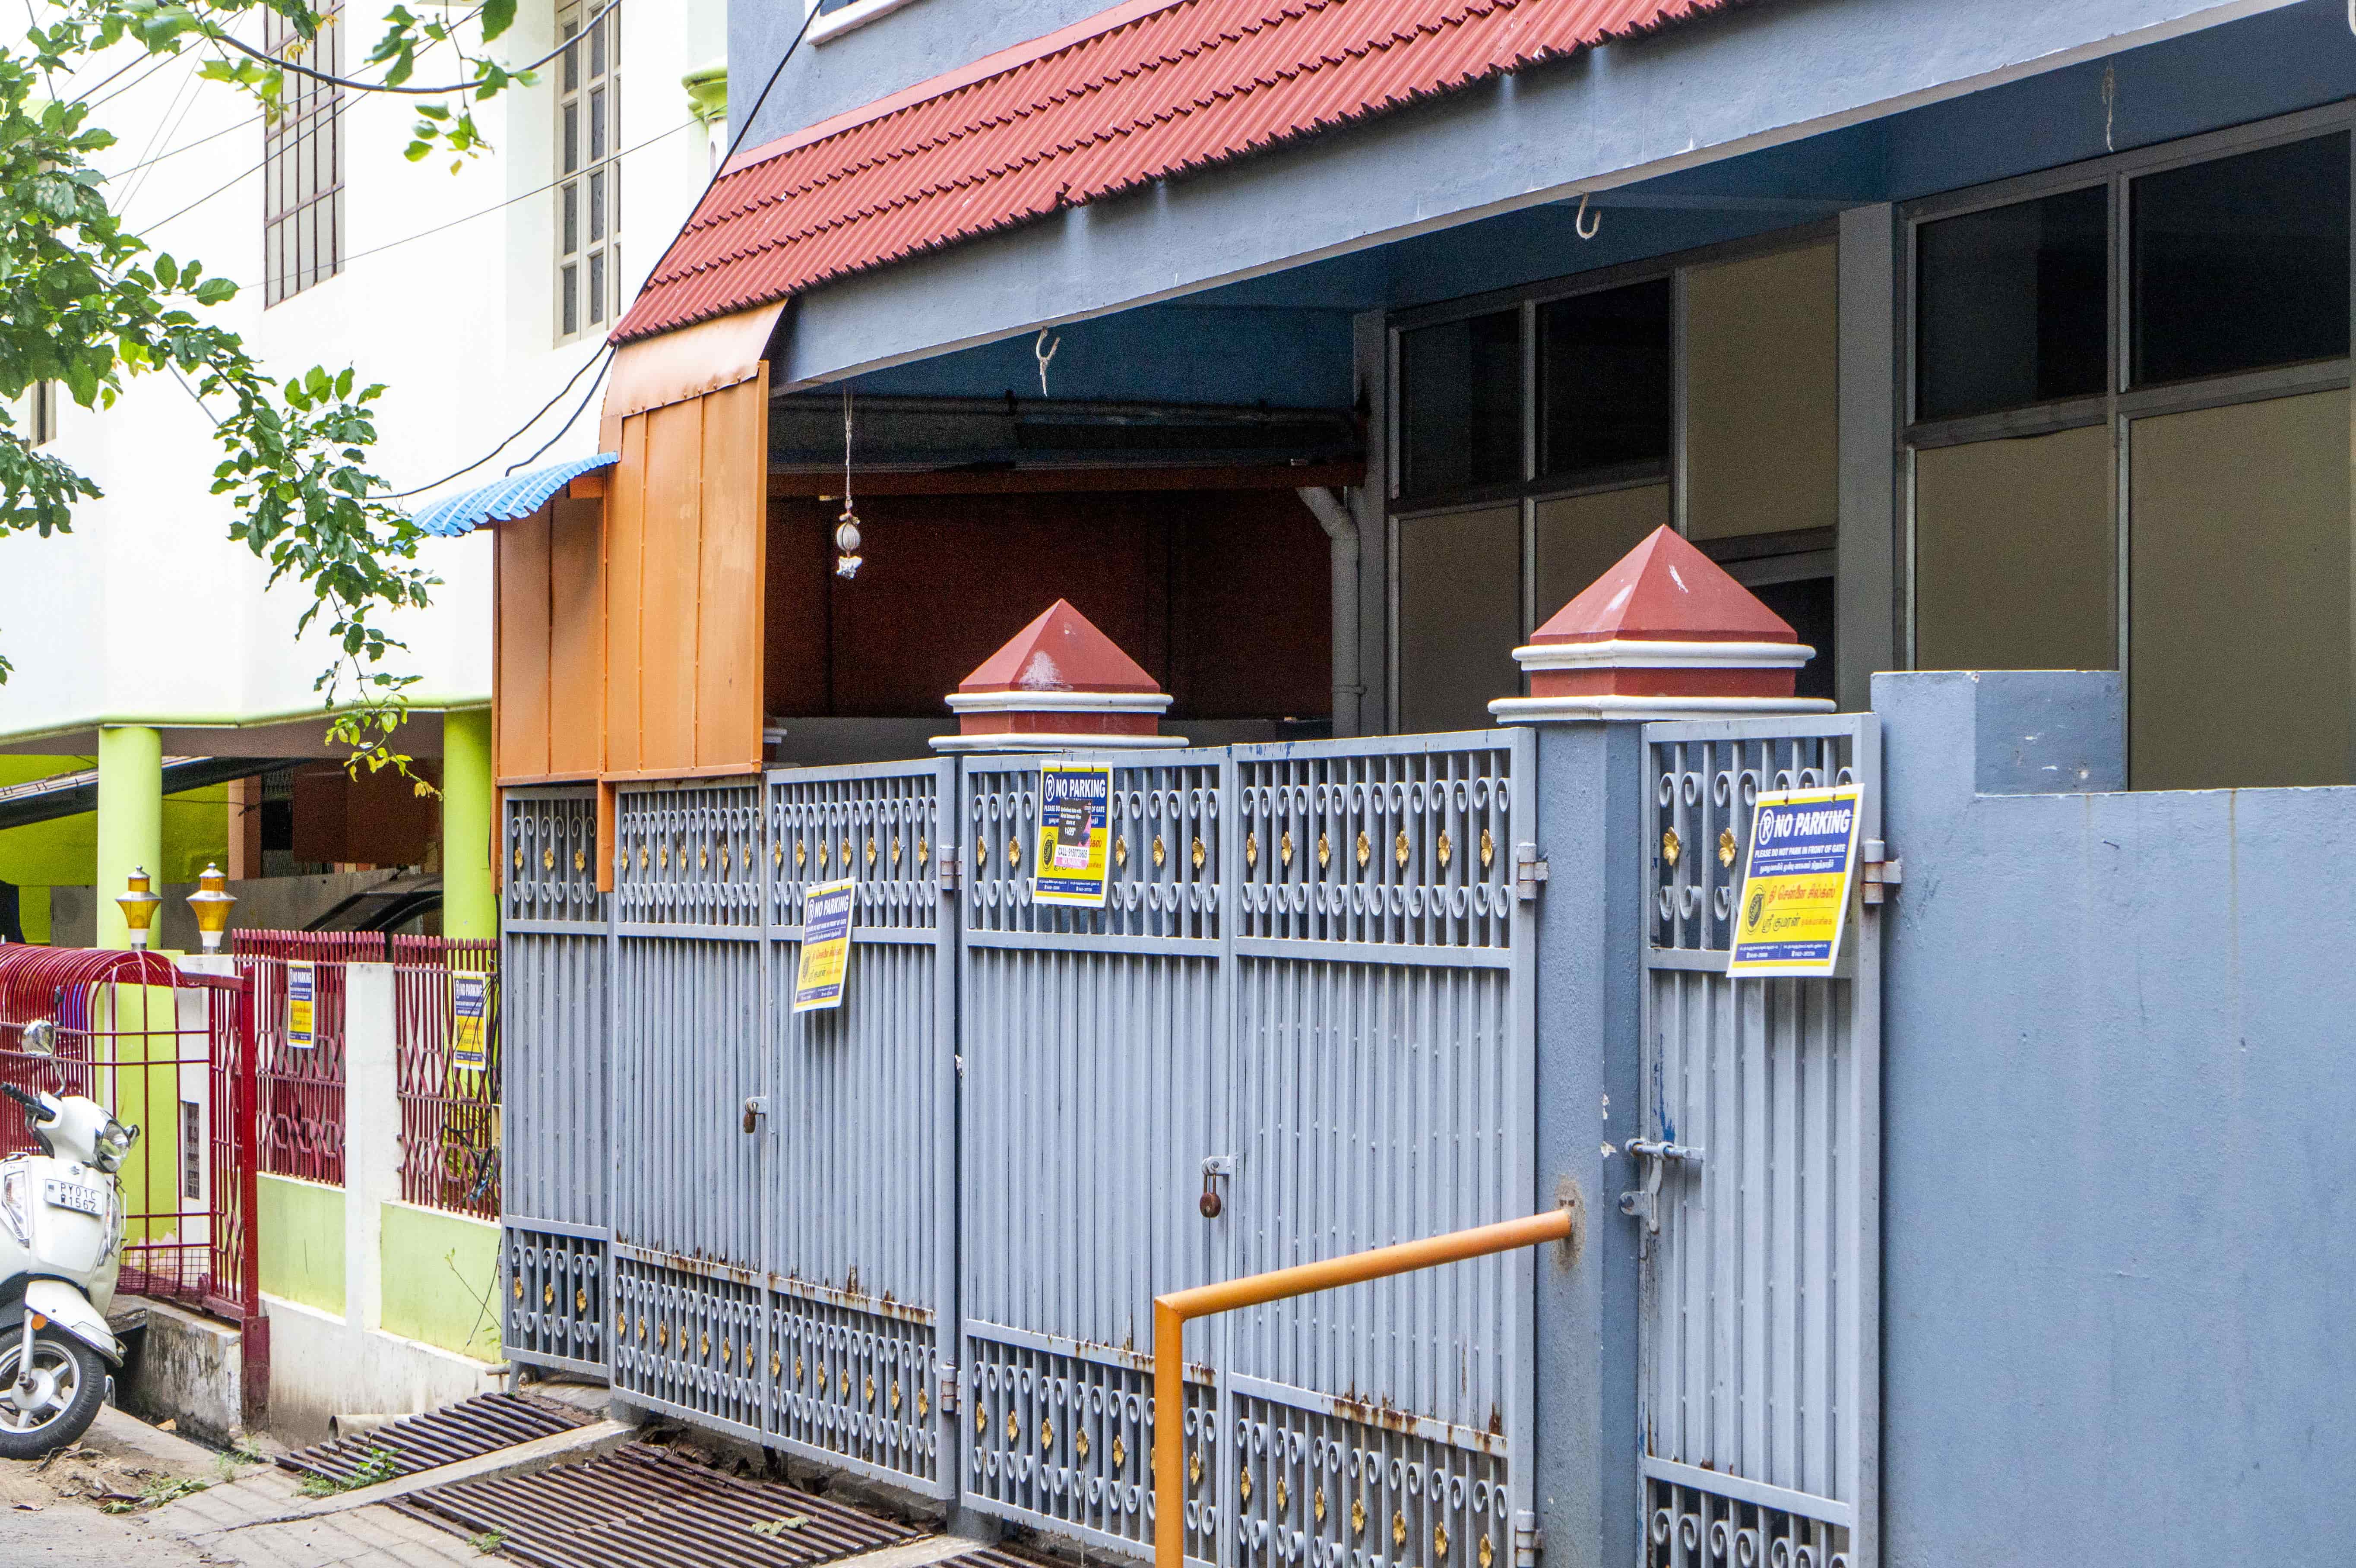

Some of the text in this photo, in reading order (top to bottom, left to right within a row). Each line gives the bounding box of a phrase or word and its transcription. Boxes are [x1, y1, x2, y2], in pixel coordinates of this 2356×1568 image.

[1056, 778, 1105, 798] NO PARKING
[1773, 809, 1851, 838] NO PARKING
[1754, 844, 1846, 858] PLEASE DO NOT PARK IN FRONT OF GATE
[814, 895, 849, 918] NO PARKING
[293, 971, 311, 983] NO PARKING
[460, 983, 483, 998] NO PARKING
[60, 1182, 96, 1201] PY01C
